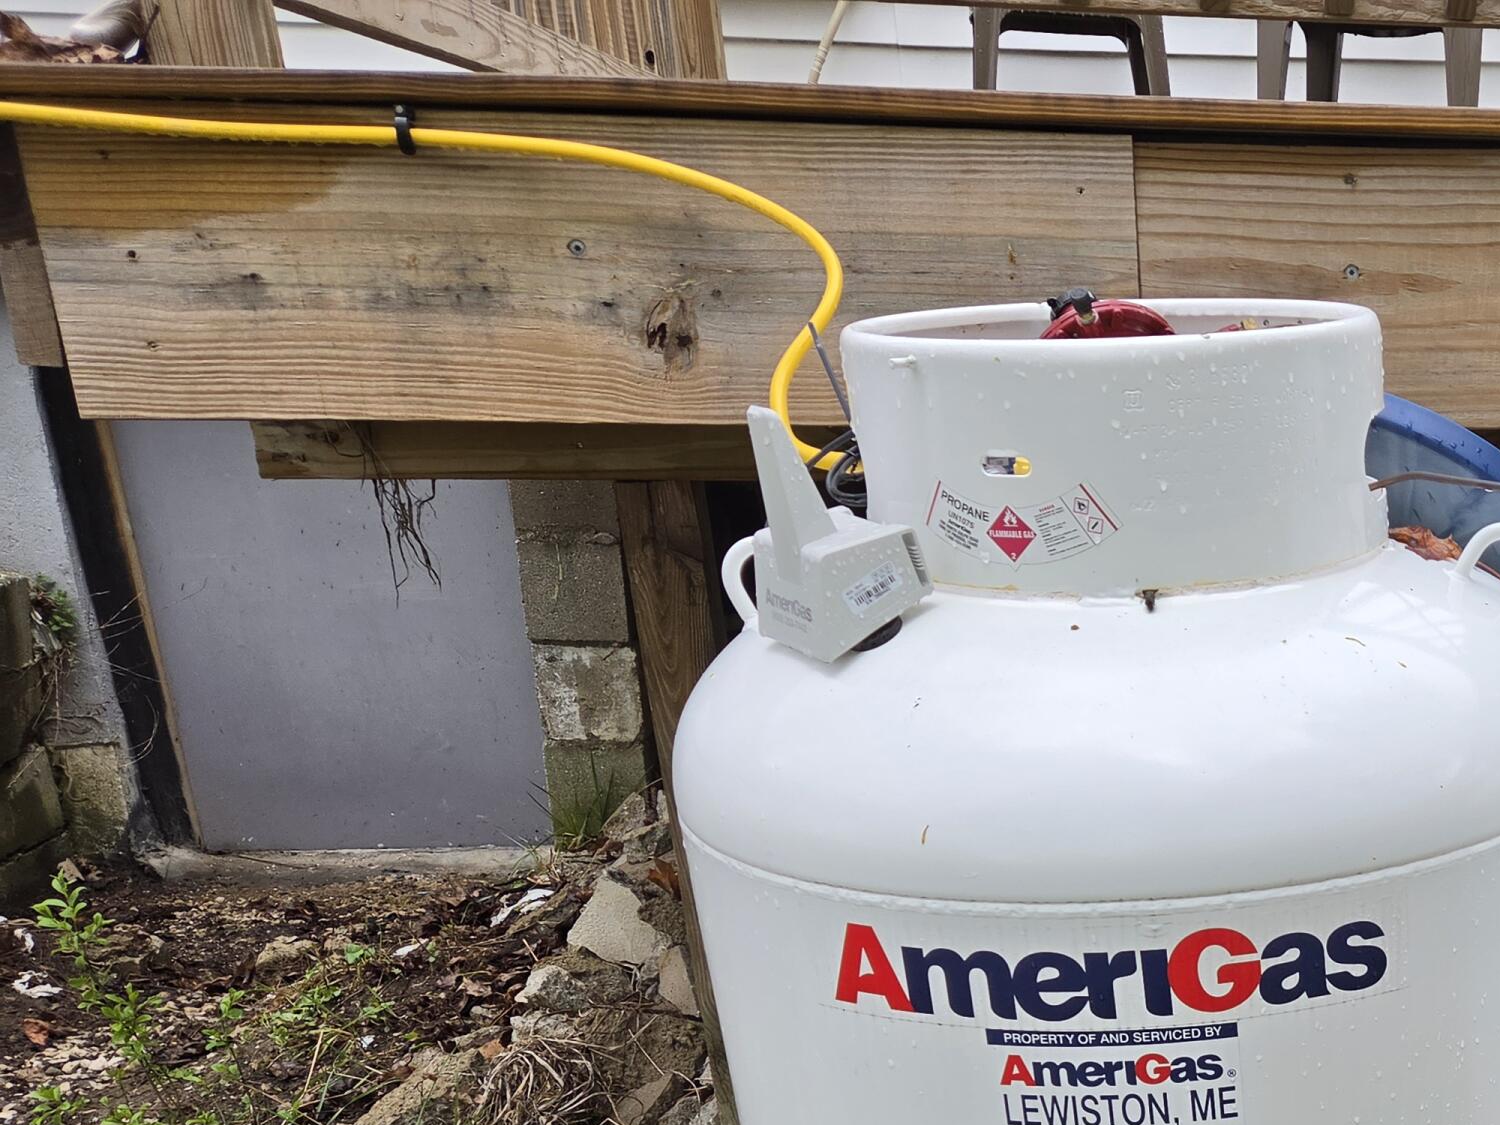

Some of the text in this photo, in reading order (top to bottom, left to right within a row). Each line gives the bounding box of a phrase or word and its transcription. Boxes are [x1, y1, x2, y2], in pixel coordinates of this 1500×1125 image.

[941, 490, 990, 522] PROPANE
[948, 510, 976, 529] UN1075
[835, 921, 1387, 1021] AmeriGas
[1003, 1025, 1222, 1045] PROPERTY OF AND SERVICED BY
[1000, 1053, 1224, 1087] AmeriGas
[1190, 1085, 1239, 1122] ME
